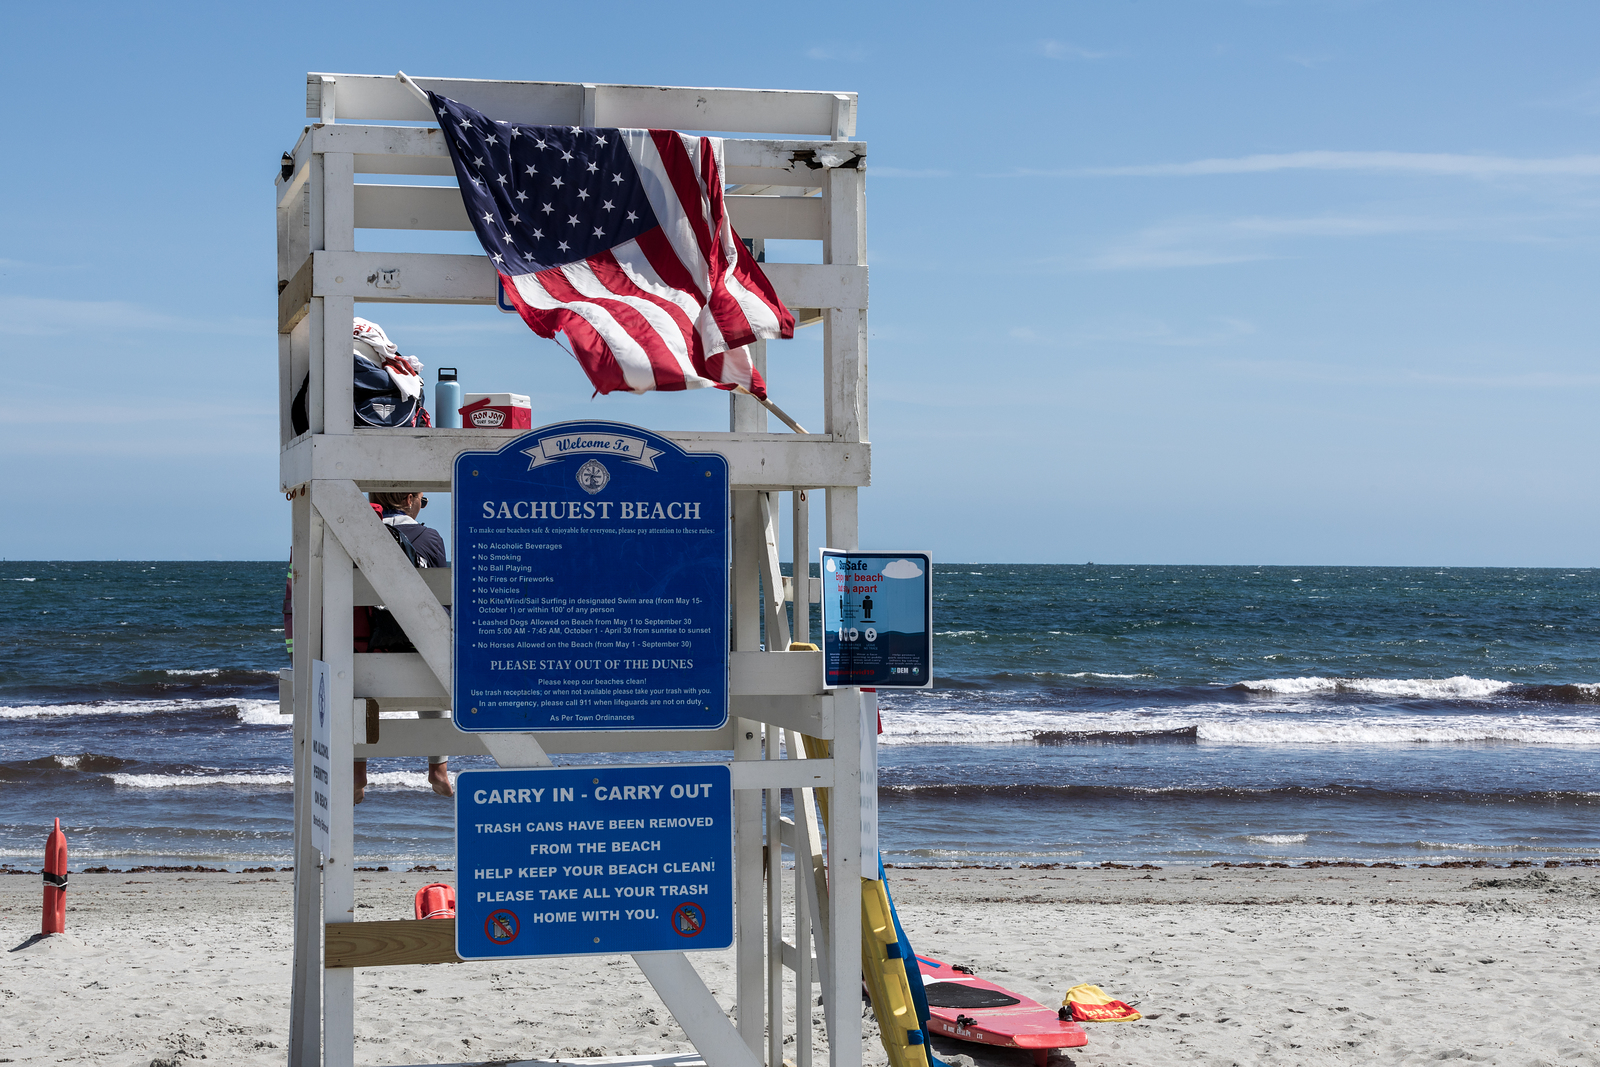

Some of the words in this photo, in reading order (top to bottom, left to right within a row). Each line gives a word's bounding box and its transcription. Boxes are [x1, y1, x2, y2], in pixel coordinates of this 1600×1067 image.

[473, 411, 487, 421] RON
[488, 412, 503, 421] JON
[556, 437, 610, 452] Welcome
[612, 439, 630, 452] To
[483, 501, 614, 519] SACHUEST
[620, 502, 701, 519] BEACH
[618, 527, 636, 535] please
[490, 554, 521, 562] Smoking
[846, 560, 868, 570] Safe
[854, 573, 883, 581] beach
[852, 585, 878, 594] apart
[541, 598, 567, 606] Surfing
[577, 598, 616, 606] designated
[655, 598, 674, 606] (from
[676, 598, 690, 606] May
[510, 619, 529, 627] Dogs
[614, 618, 628, 626] May
[645, 618, 682, 626] September
[605, 628, 622, 636] April
[616, 641, 630, 649] May
[491, 660, 536, 670] PLEASE
[540, 660, 571, 669] STAY
[575, 660, 601, 669] OUT
[605, 660, 621, 669] OF
[624, 660, 649, 669] THE
[652, 659, 693, 669] DUNES
[614, 699, 649, 707] lifeguards
[474, 788, 545, 804] CARRY
[553, 787, 574, 802] IN
[594, 785, 664, 801] CARRY
[670, 783, 713, 799] OUT
[475, 823, 521, 833] TRASH
[527, 822, 563, 832] CANS
[569, 820, 604, 831] HAVE
[609, 819, 644, 829] BEEN
[650, 817, 713, 828] REMOVED
[531, 843, 571, 855] FROM
[577, 842, 606, 853] THE
[612, 841, 660, 852] BEACH
[475, 868, 513, 879] HELP
[519, 867, 557, 878] KEEP
[563, 865, 603, 877] YOUR
[609, 864, 658, 875] BEACH
[663, 862, 715, 873] CLEAN!
[478, 890, 534, 902] PLEASE
[539, 889, 578, 900] TAKE
[583, 888, 610, 898] ALL
[615, 886, 655, 898] YOUR
[660, 884, 708, 896] TRASH
[534, 912, 577, 923] HOME
[582, 910, 619, 921] WITH
[625, 909, 659, 920] YOU.
